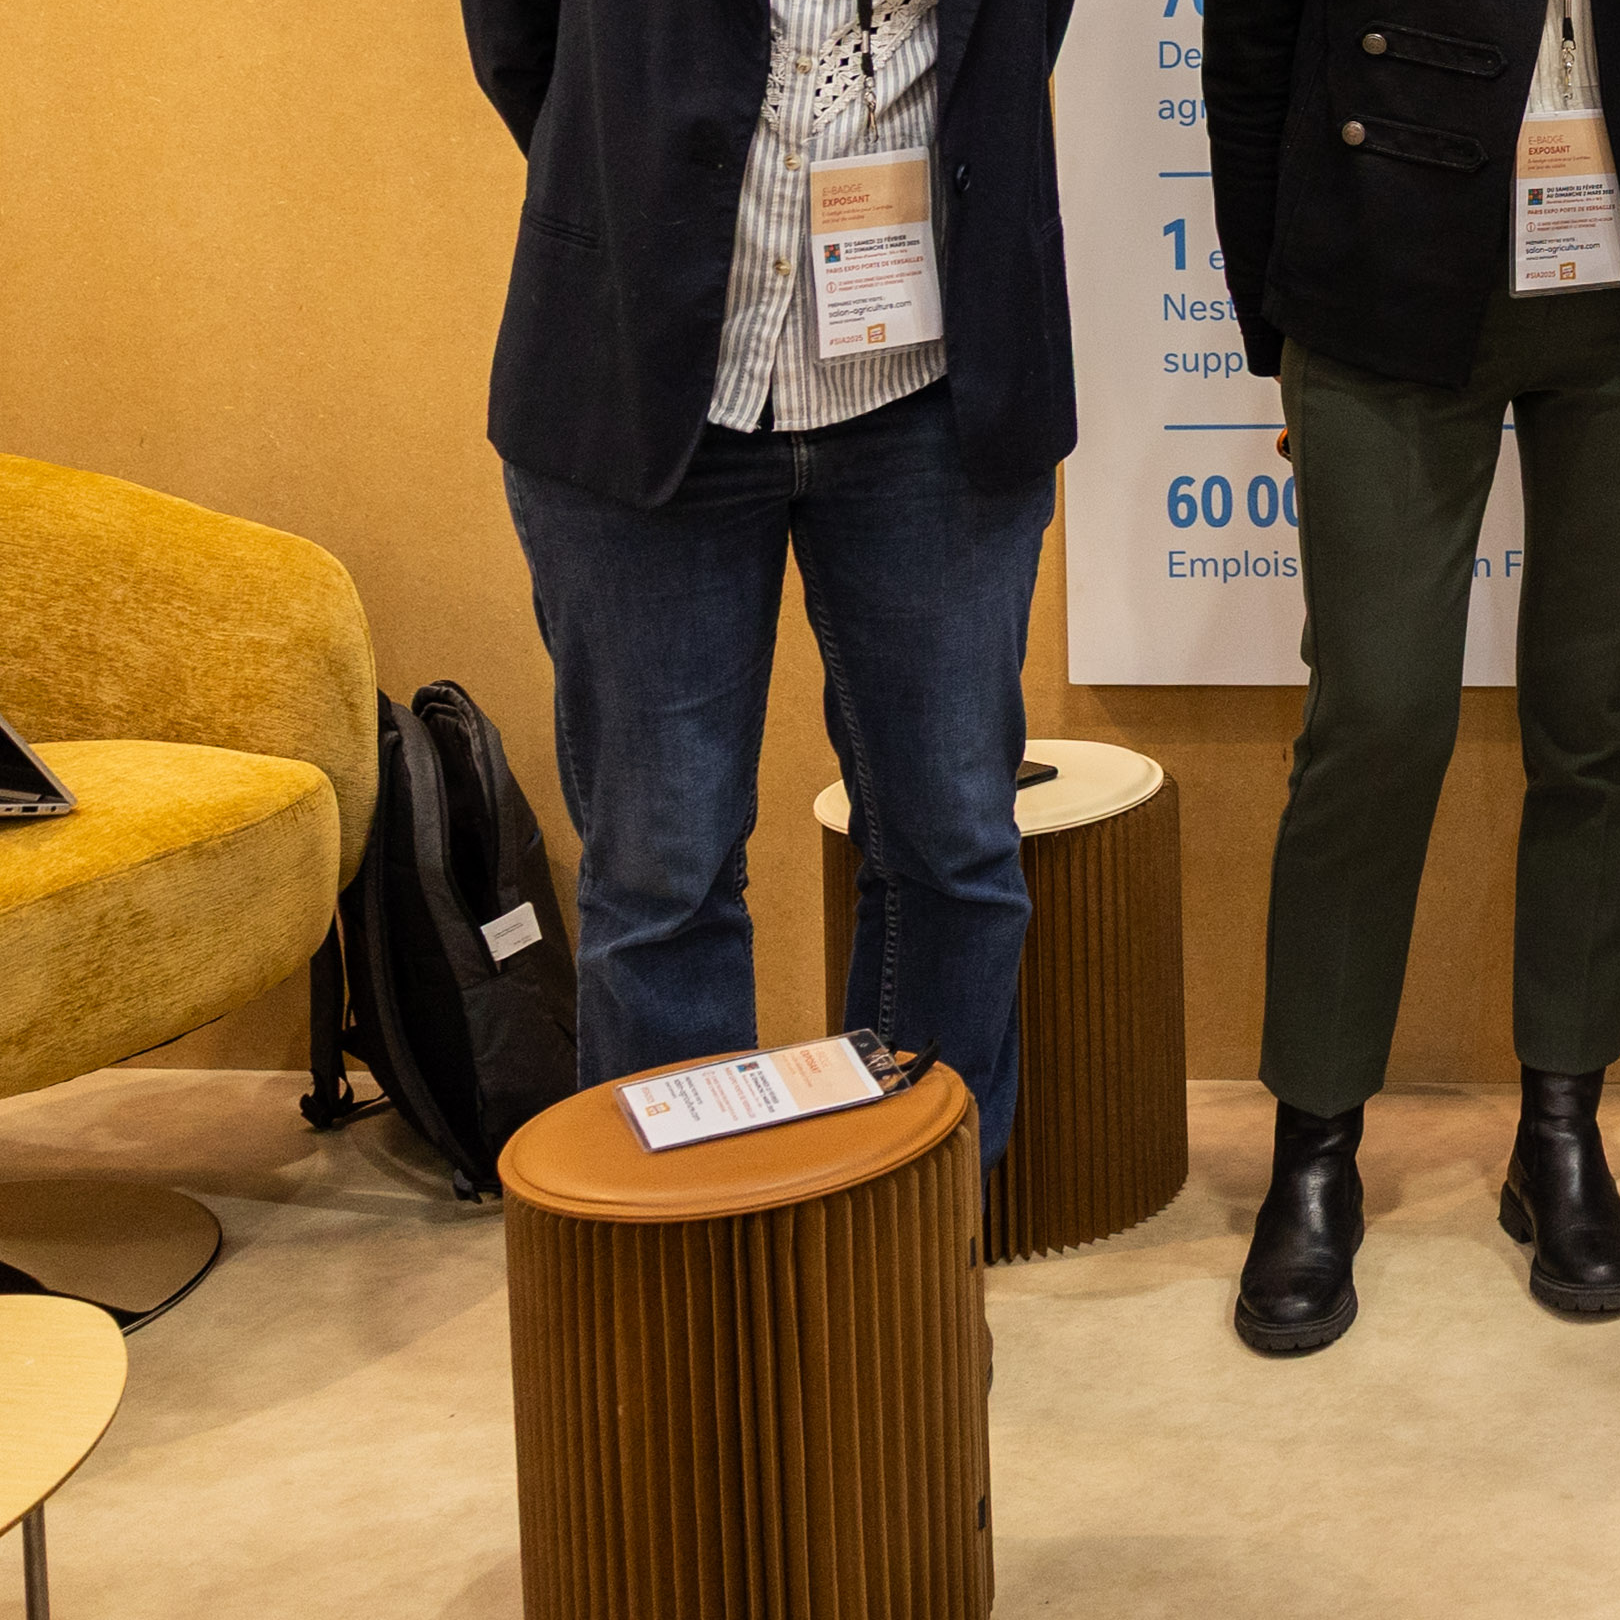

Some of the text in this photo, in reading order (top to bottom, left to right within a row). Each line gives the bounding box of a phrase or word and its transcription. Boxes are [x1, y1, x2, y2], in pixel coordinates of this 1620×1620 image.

[1528, 145, 1571, 155] EXPOSANT
[822, 194, 871, 208] EXPOSANT
[1163, 218, 1186, 270] 1
[1167, 475, 1233, 528] 60
[1169, 550, 1298, 584] Emplois
